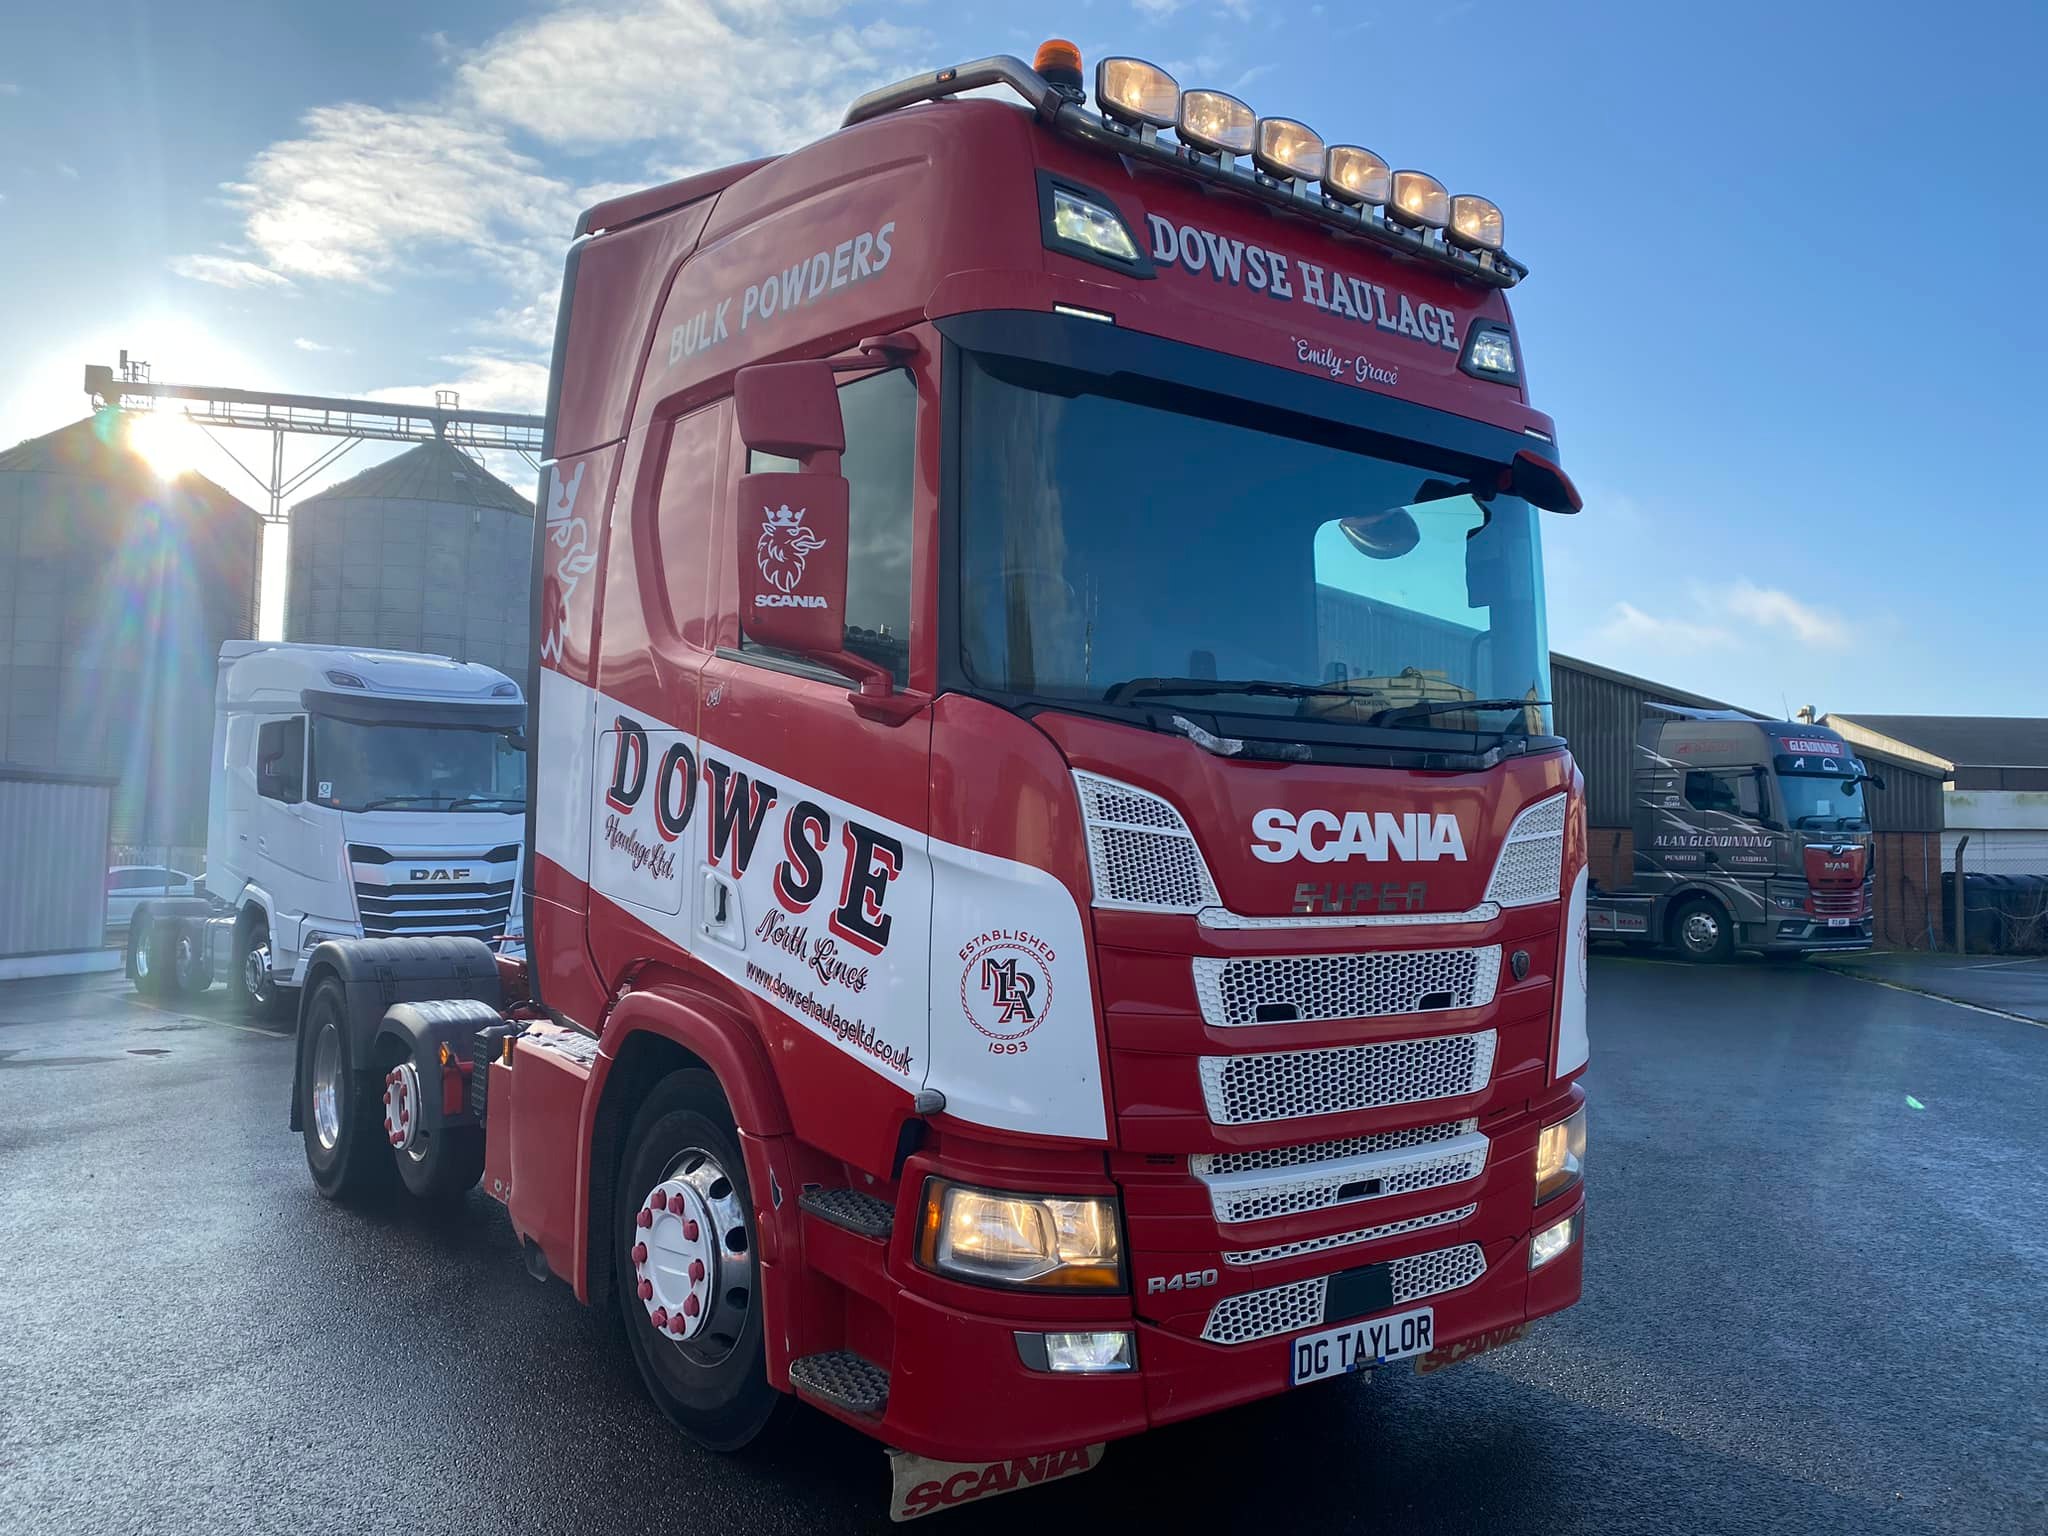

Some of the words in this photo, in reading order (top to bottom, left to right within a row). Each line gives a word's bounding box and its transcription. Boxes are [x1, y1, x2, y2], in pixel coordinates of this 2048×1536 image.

[668, 297, 732, 367] BULK
[740, 222, 897, 330] POWDERS
[1147, 213, 1293, 300] DOWSE
[1297, 258, 1460, 352] HAULAGE
[755, 594, 828, 608] SCANIA
[605, 714, 905, 956] DOWSE
[1250, 808, 1468, 864] SCANIA
[1654, 835, 1687, 848] ALAN
[1689, 835, 1773, 848] GLENDINNING
[410, 868, 470, 880] DAF
[1292, 881, 1427, 913] SUPER
[755, 907, 808, 961] North
[959, 929, 1056, 962] ESTABLISHED
[746, 960, 914, 1076] www.dowsehaulageltd.co.uk
[988, 1041, 1028, 1055] 1993
[1147, 1269, 1219, 1295] R450
[1297, 1340, 1329, 1380] DG
[1337, 1314, 1431, 1368] TAYLOR
[901, 1446, 1091, 1517] SCANIA
